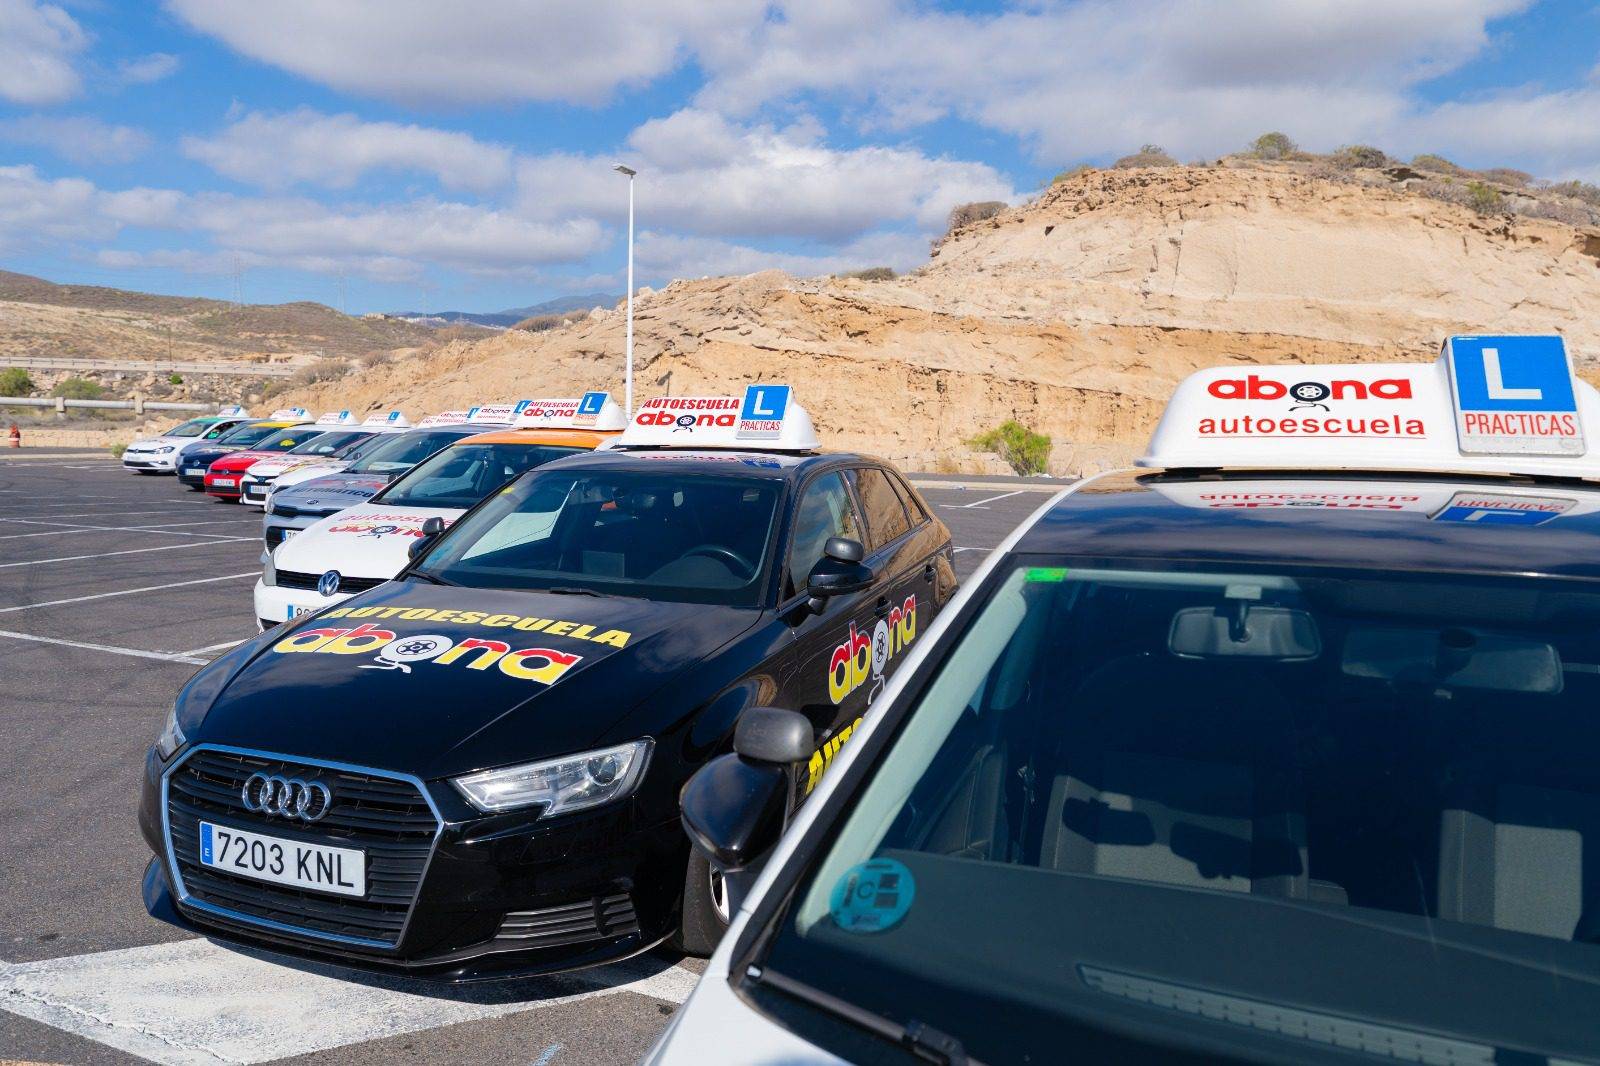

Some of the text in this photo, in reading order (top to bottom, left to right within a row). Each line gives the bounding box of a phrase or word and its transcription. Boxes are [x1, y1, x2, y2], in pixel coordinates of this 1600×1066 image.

[1482, 348, 1543, 400] L
[1207, 375, 1412, 403] abona
[523, 409, 576, 418] abona
[584, 396, 595, 411] L
[642, 398, 740, 410] AUTOESCUELA
[753, 391, 773, 415] L
[636, 412, 736, 428] abona
[740, 420, 781, 431] PRACTICAS
[1198, 414, 1426, 435] autoescuela
[1465, 413, 1576, 436] PRACTICAS
[318, 607, 632, 648] AUTOESCUELA
[273, 624, 583, 685] abona
[829, 594, 915, 704] abona
[218, 832, 285, 875] 7203
[296, 847, 354, 888] KNL
